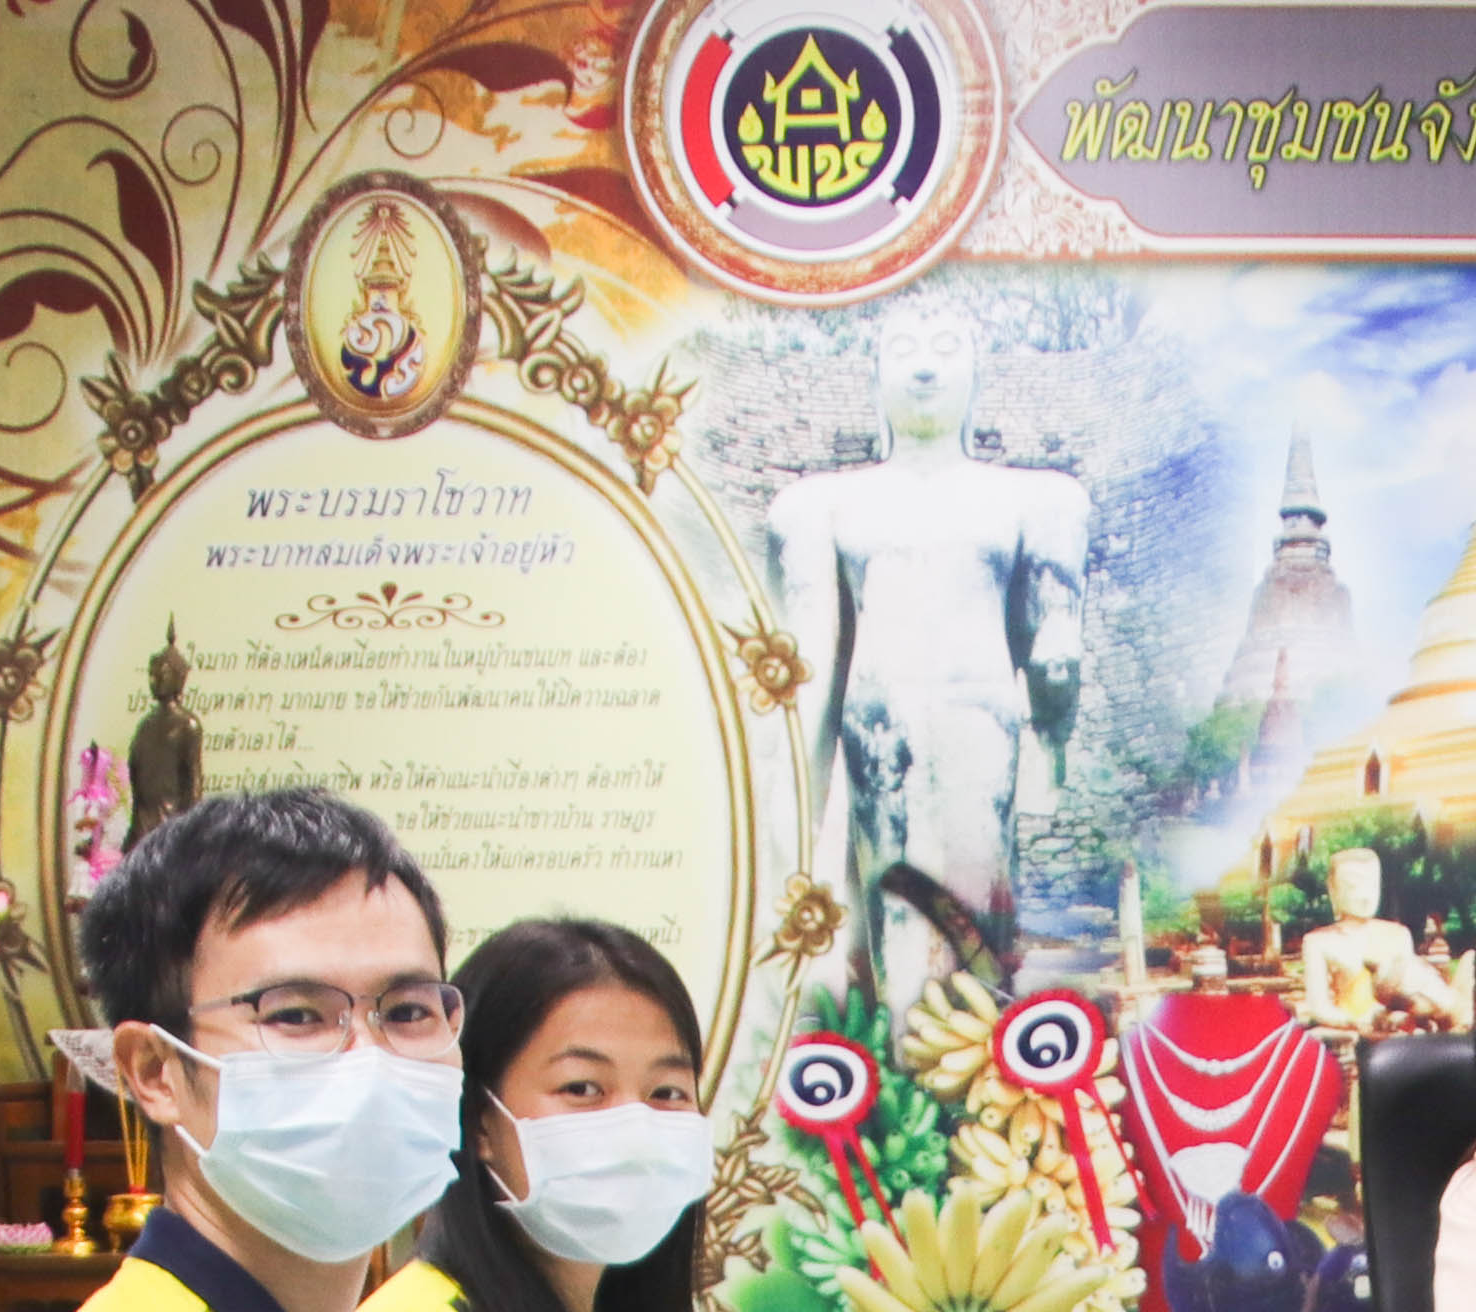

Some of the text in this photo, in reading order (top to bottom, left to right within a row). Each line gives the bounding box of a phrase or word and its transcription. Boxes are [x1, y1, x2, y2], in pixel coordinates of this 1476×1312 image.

[205, 532, 576, 574] พระบาทสมเด็จพระเจ้าอยู่หัว
